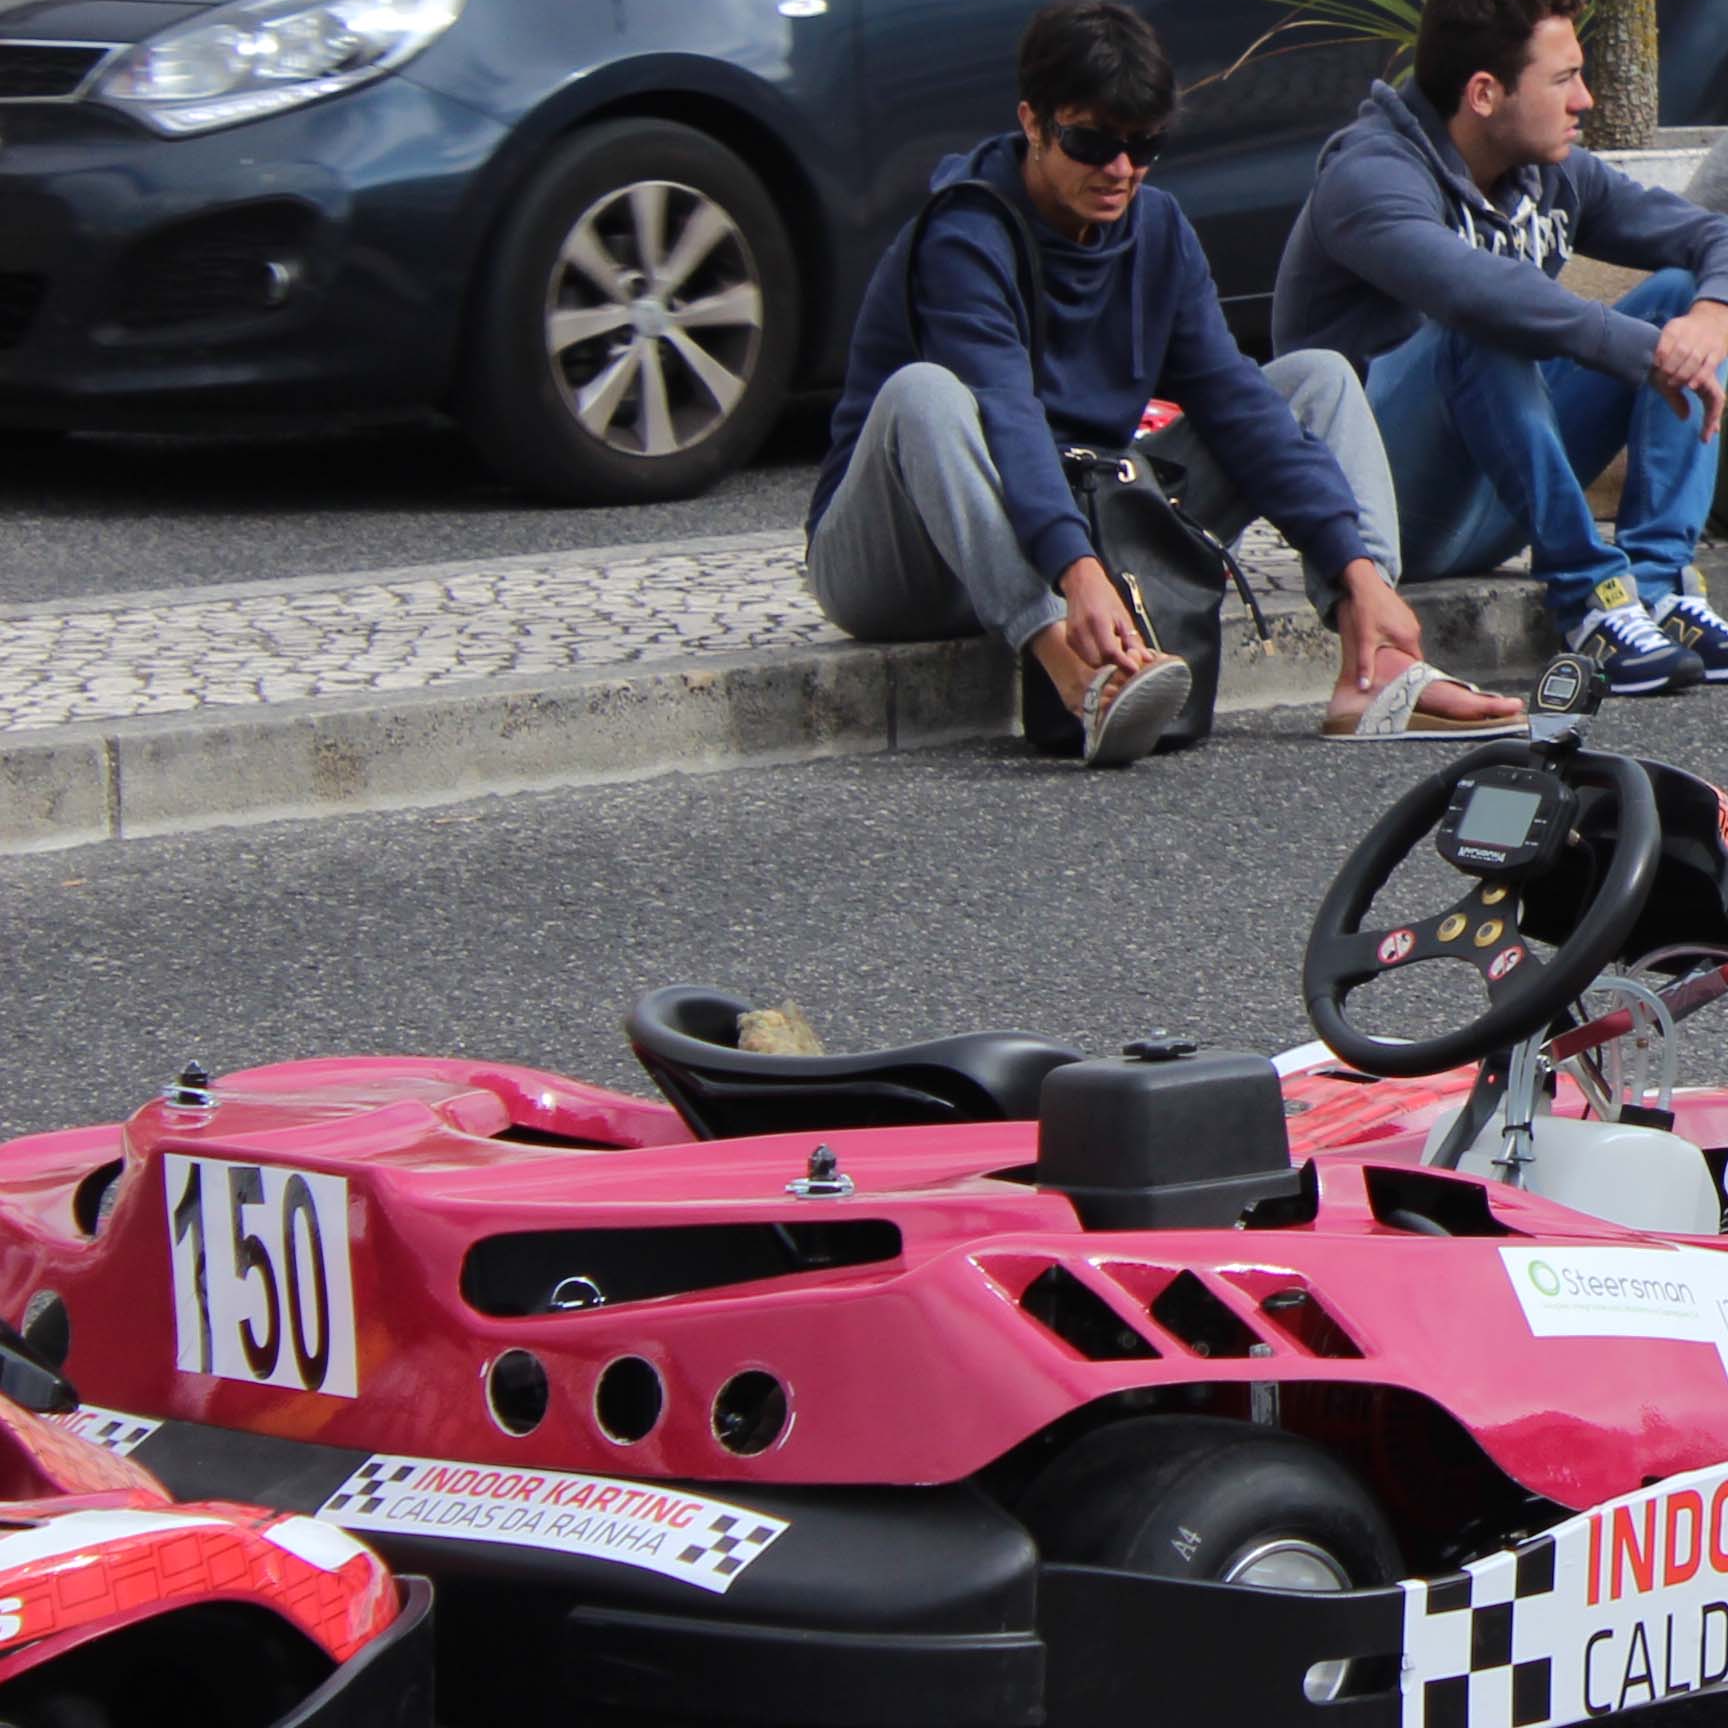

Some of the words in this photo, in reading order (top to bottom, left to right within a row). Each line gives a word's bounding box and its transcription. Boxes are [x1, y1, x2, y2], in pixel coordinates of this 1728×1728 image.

[168, 1161, 331, 1392] 150
[1561, 1268, 1697, 1305] Steersman
[385, 1496, 499, 1530] CALDAS
[500, 1506, 543, 1533] DA
[546, 1515, 669, 1557] RAINHA
[413, 1465, 545, 1502] INDOOR
[540, 1475, 705, 1529] KARTING
[1170, 1525, 1203, 1563] A4
